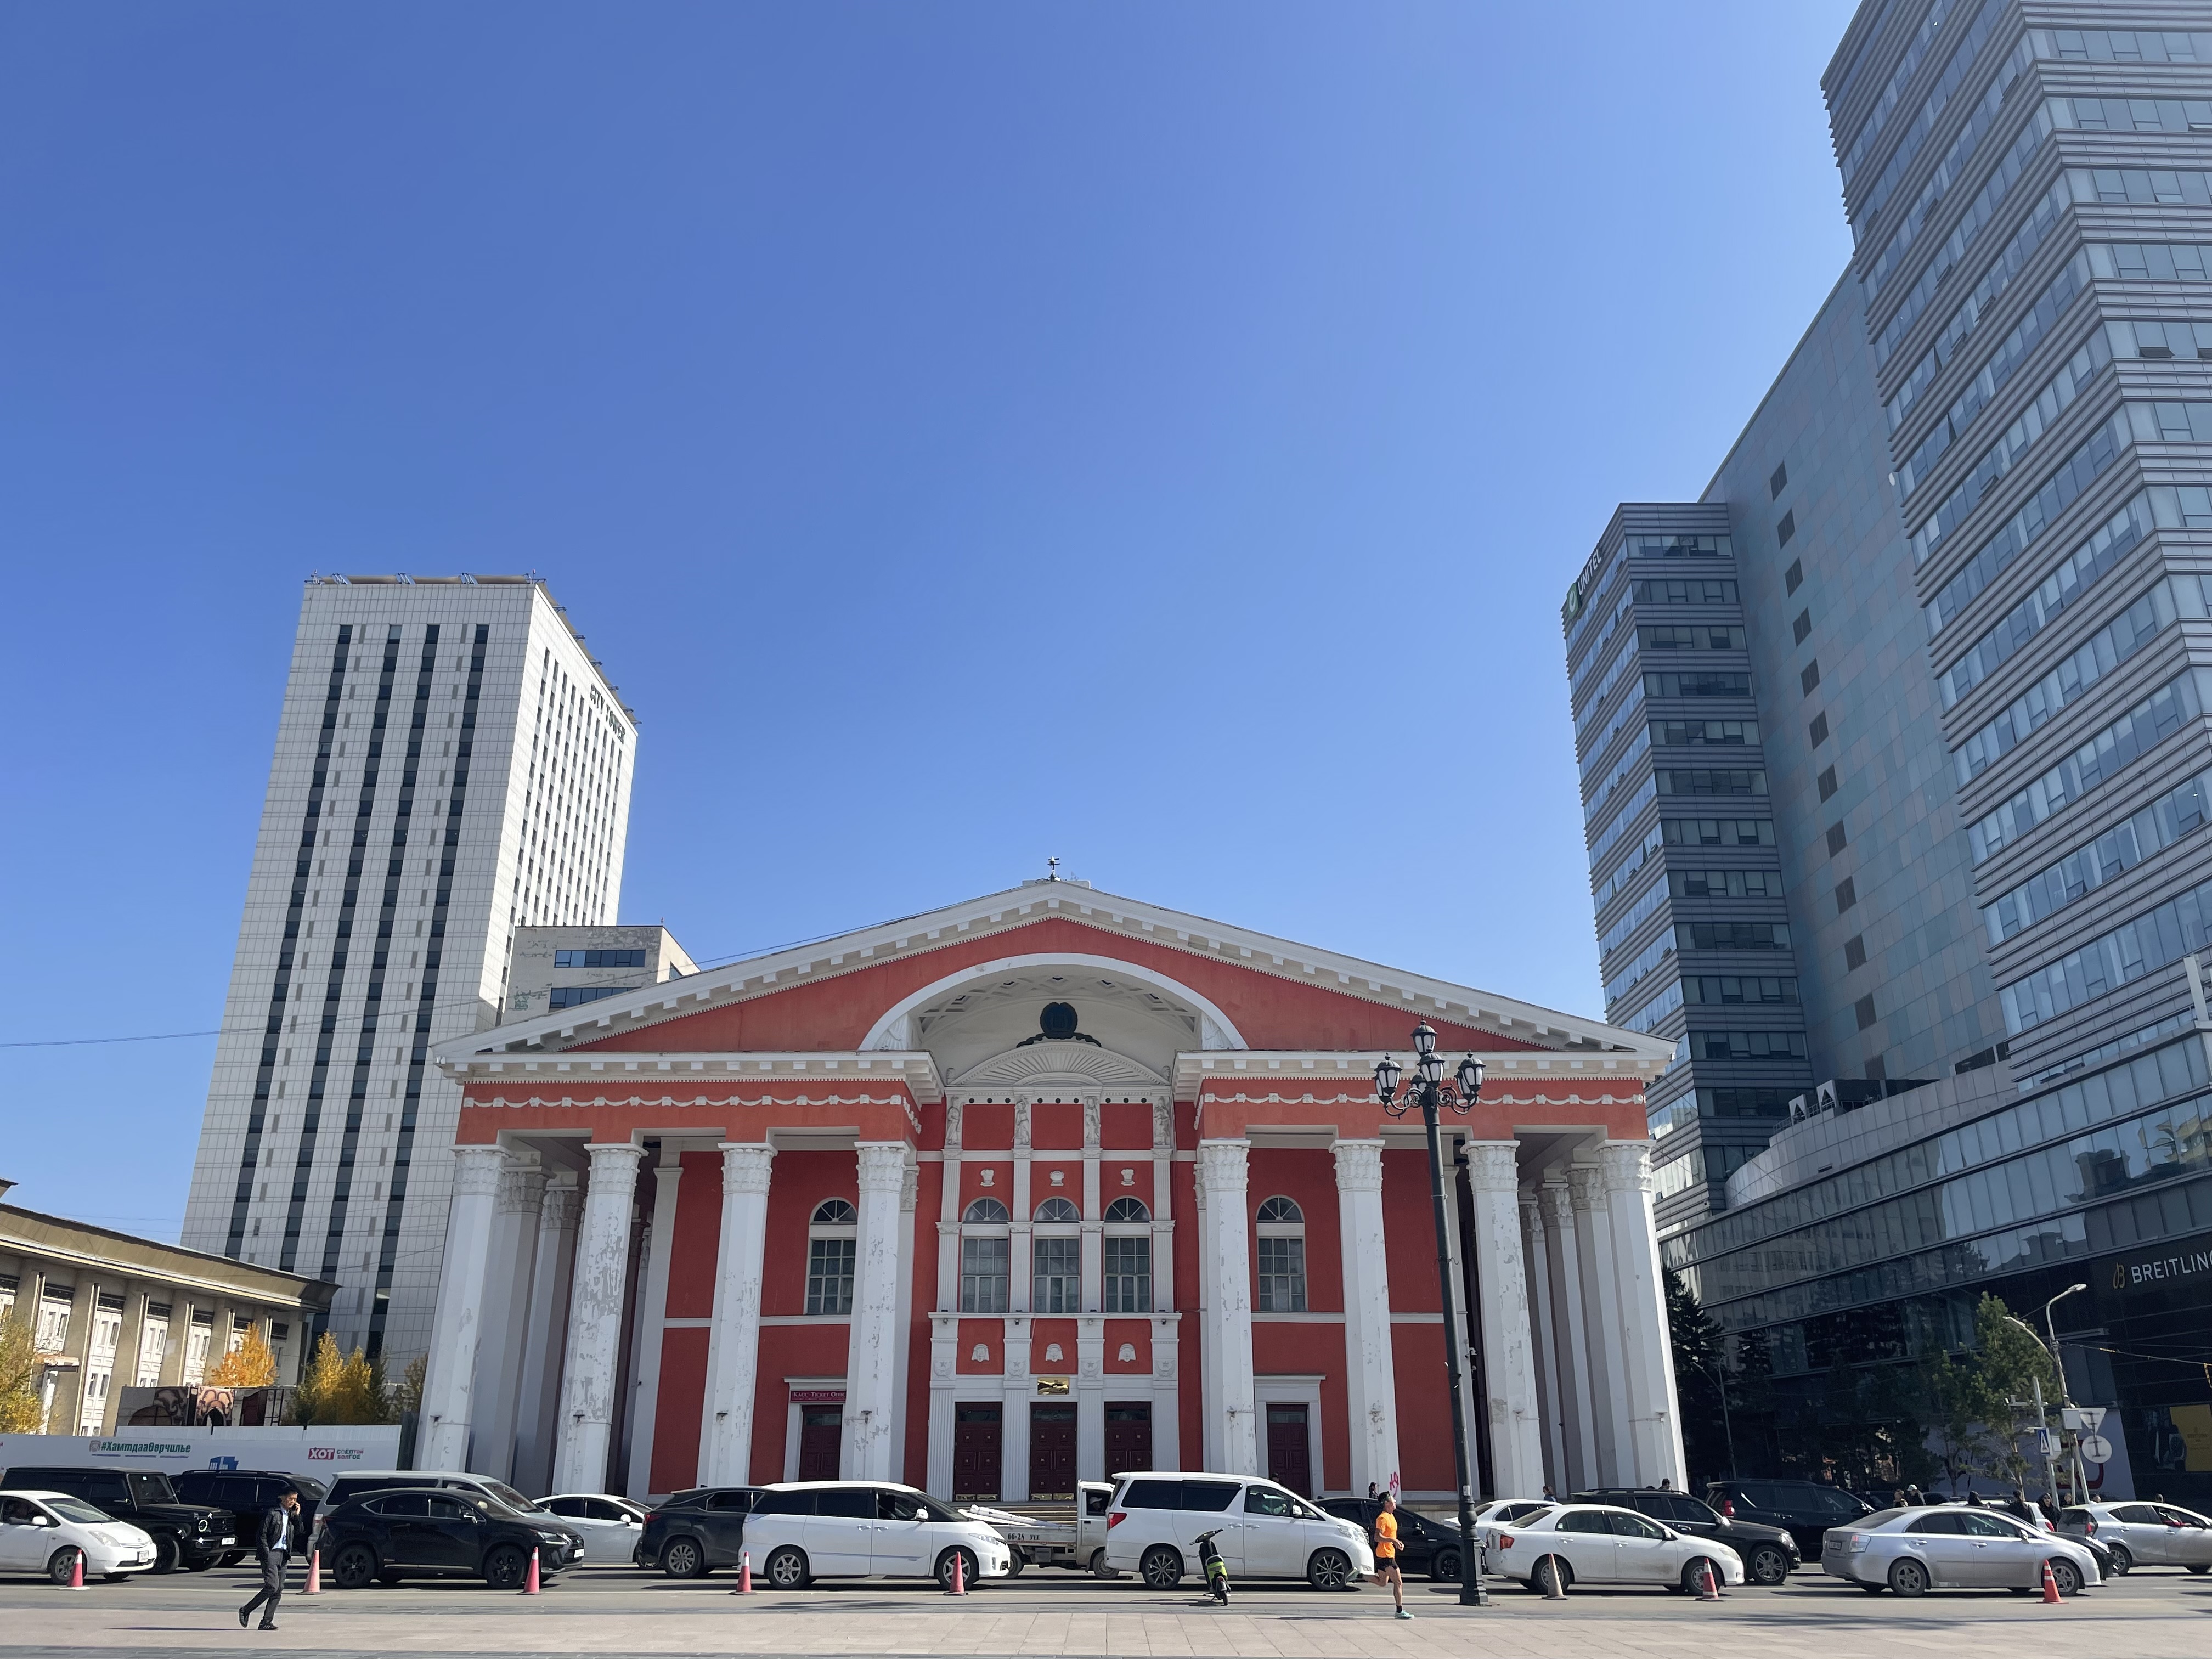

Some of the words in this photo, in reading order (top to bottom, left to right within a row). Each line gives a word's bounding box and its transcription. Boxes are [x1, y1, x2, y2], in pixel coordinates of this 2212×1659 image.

[1578, 549, 1601, 595] UNITEL
[590, 684, 605, 714] CITY
[606, 704, 625, 744] TOWER
[2131, 1250, 2212, 1283] BREITLIN
